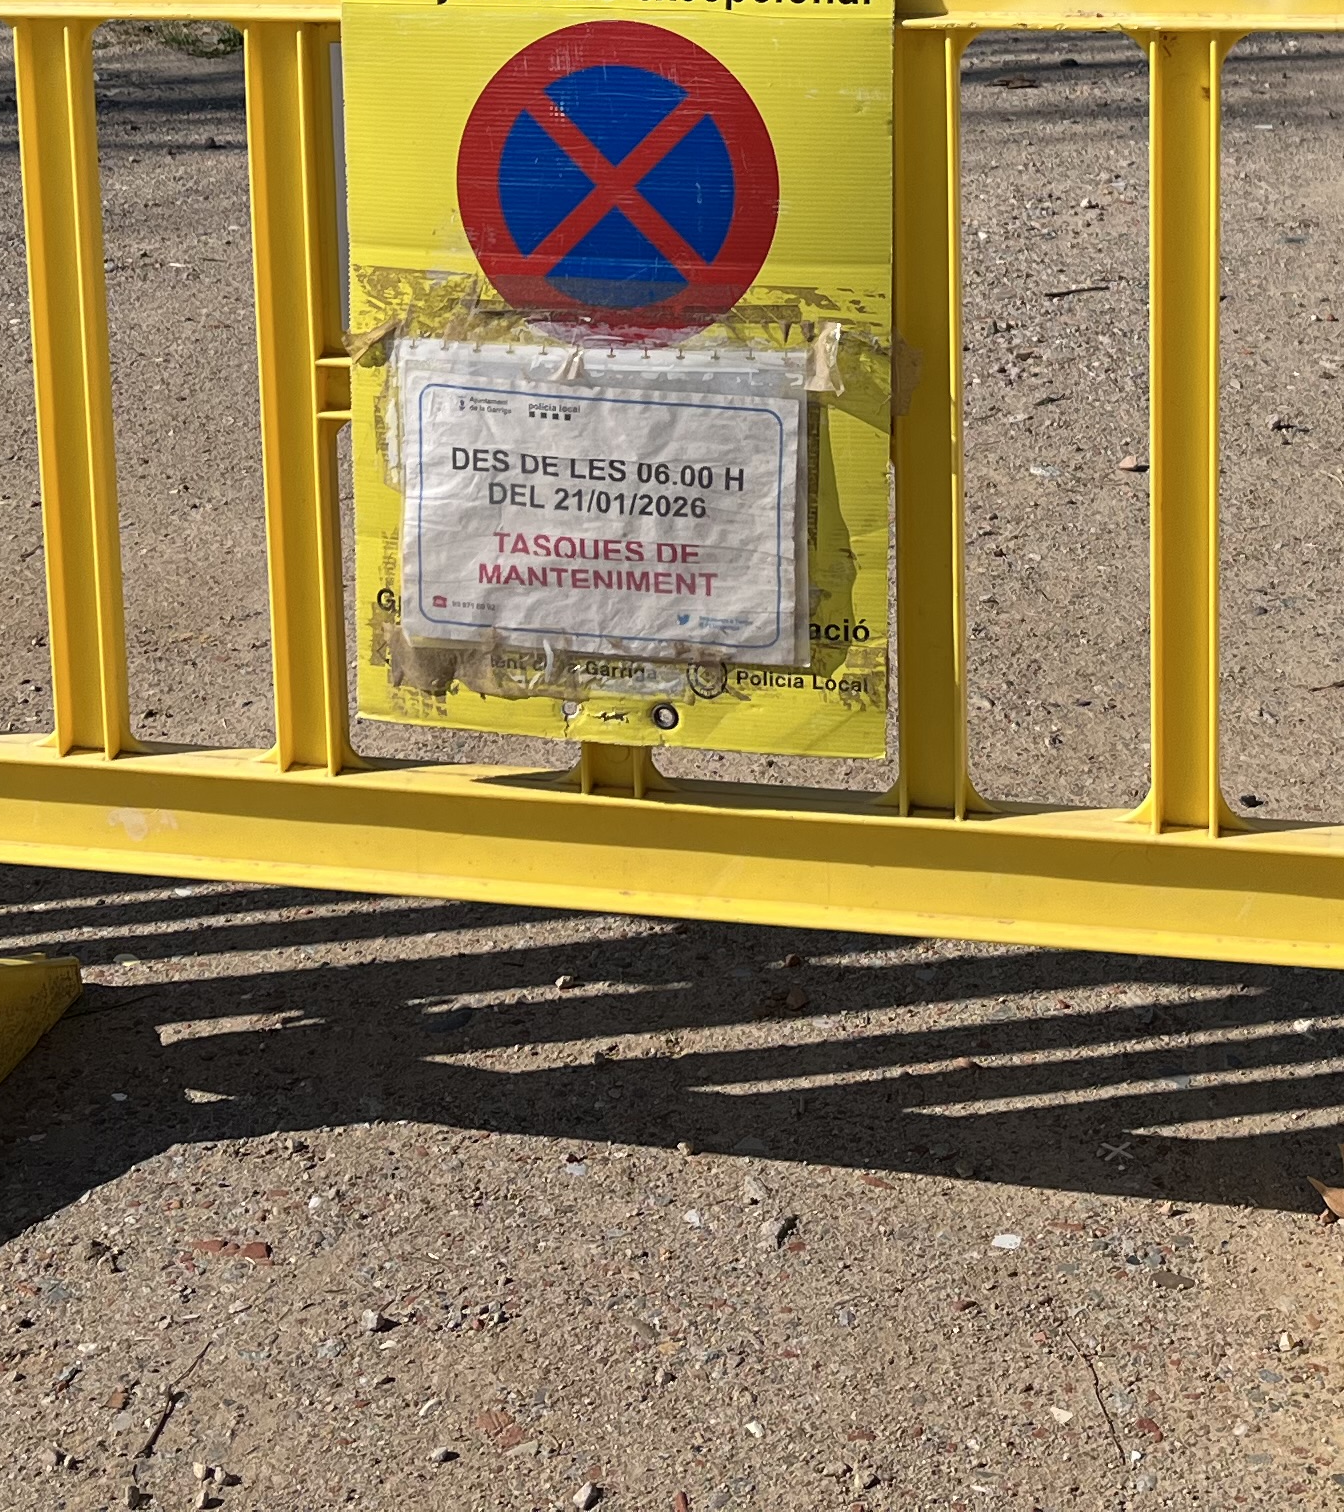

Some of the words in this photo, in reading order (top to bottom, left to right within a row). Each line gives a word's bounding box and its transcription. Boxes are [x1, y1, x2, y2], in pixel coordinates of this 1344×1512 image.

[469, 396, 508, 405] Ajuntament
[487, 406, 512, 416] Garriga
[528, 403, 558, 412] policia
[559, 404, 581, 414] local
[452, 447, 510, 473] DES
[520, 453, 559, 478] DE
[570, 458, 627, 483] LES
[637, 462, 714, 489] 06.00
[725, 467, 745, 492] H
[488, 482, 545, 509] DEL
[554, 488, 707, 519] 21/01/2026
[493, 531, 645, 562] TASQUES
[657, 542, 701, 564] DE
[478, 563, 719, 597] MANTENIMENT
[736, 670, 805, 689] Policia
[812, 674, 868, 693] Local
